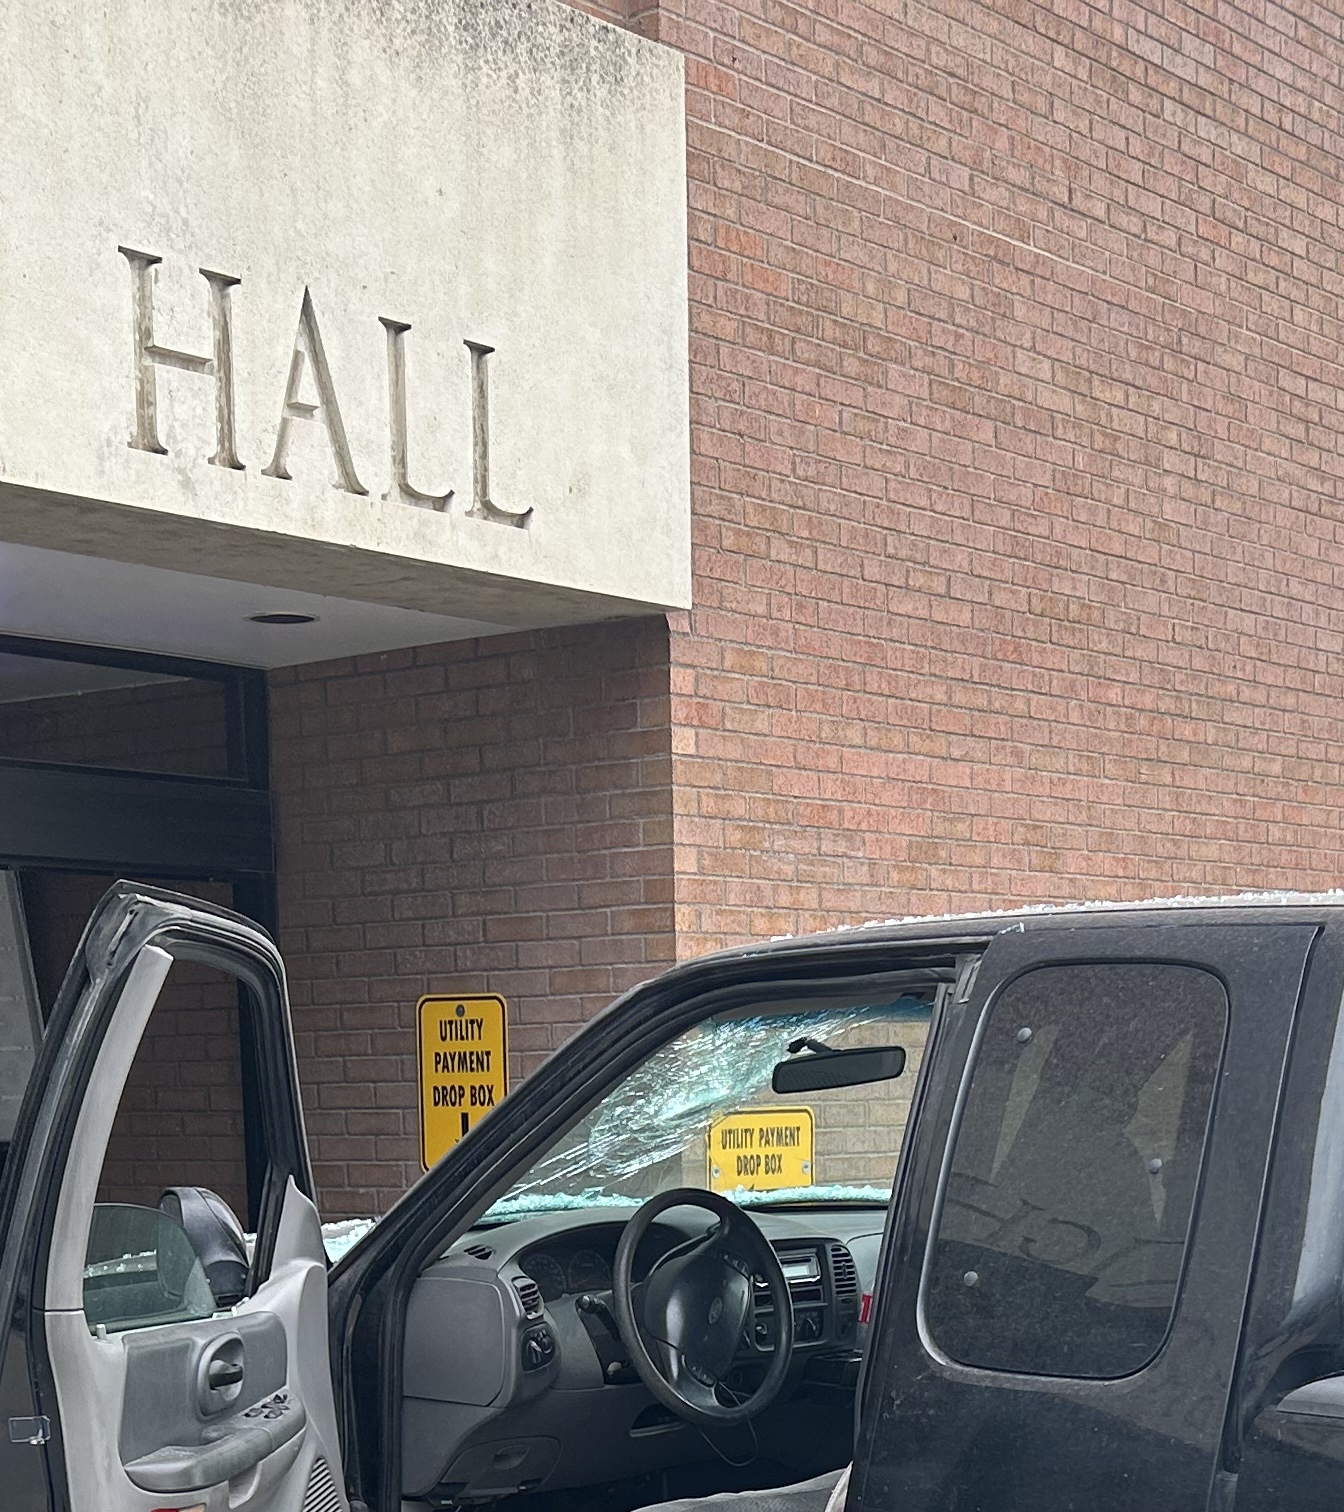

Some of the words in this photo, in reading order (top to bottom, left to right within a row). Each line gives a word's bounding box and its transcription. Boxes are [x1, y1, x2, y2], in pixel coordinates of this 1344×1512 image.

[117, 244, 534, 530] HALL
[439, 1018, 483, 1042] UTILITY
[434, 1050, 491, 1073] PAYMENT
[432, 1085, 465, 1107] DROP
[470, 1084, 495, 1107] BOX
[721, 1128, 755, 1149] UTILITY
[758, 1126, 800, 1148] PAYMENT
[737, 1154, 761, 1176] DROP
[765, 1154, 782, 1175] BOX
